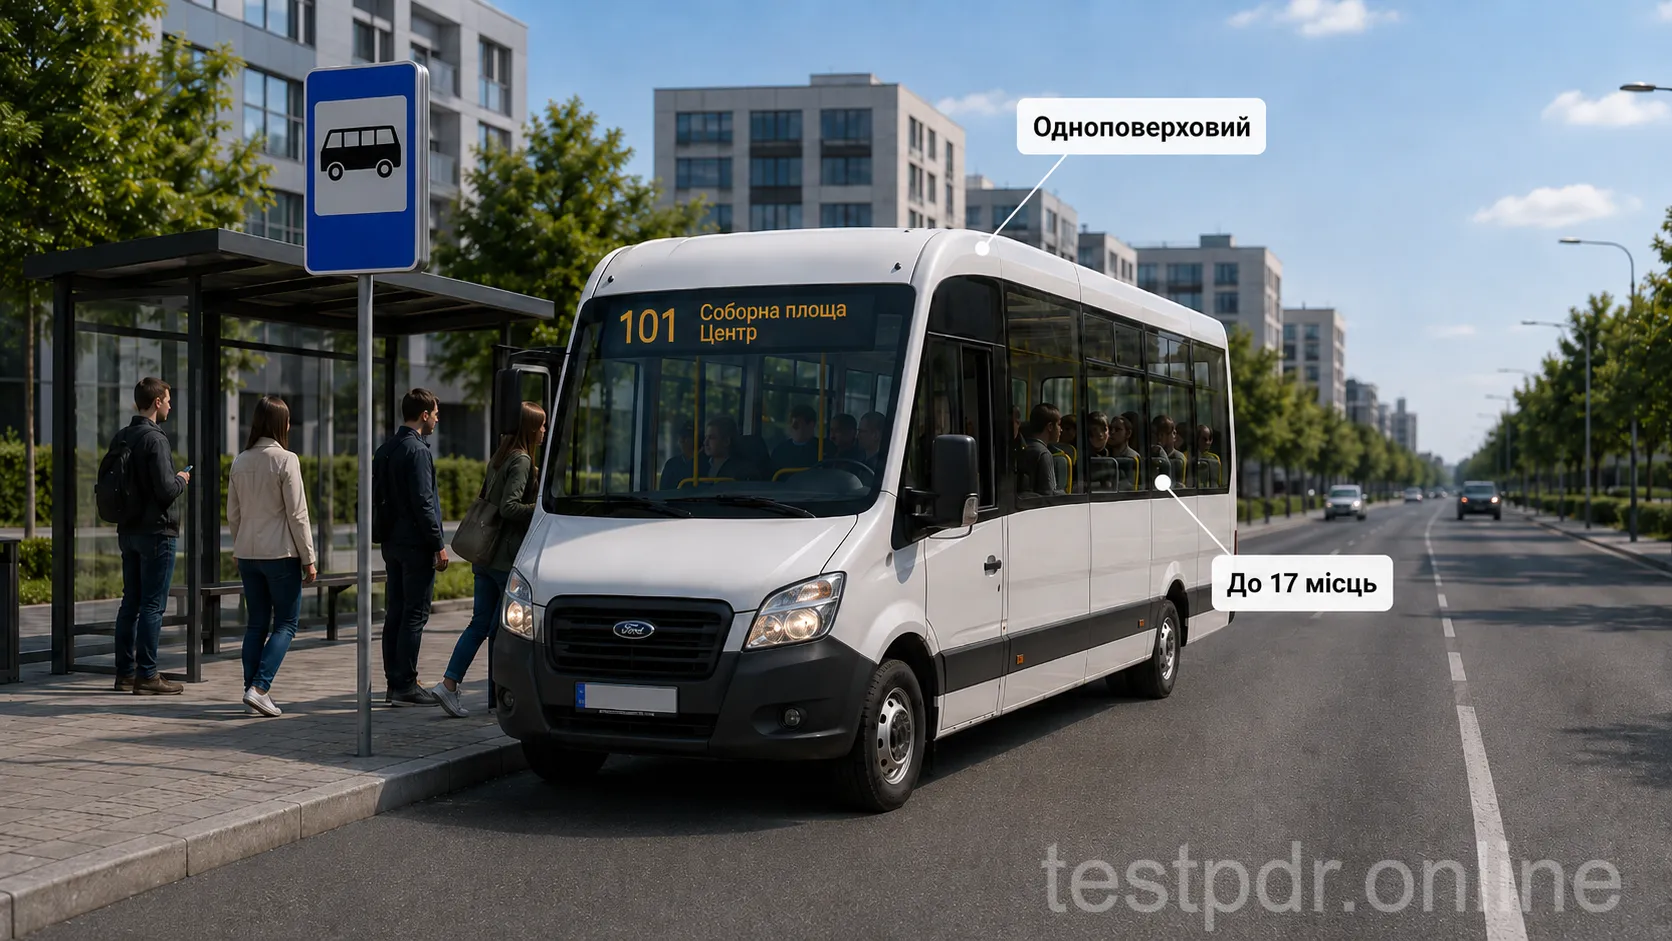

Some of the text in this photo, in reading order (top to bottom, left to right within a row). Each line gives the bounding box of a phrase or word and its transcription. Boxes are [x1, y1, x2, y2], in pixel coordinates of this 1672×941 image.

[700, 302, 847, 324] Соборна площа
[619, 307, 676, 344] 101
[700, 324, 757, 345] Центр
[621, 623, 645, 635] Ford
